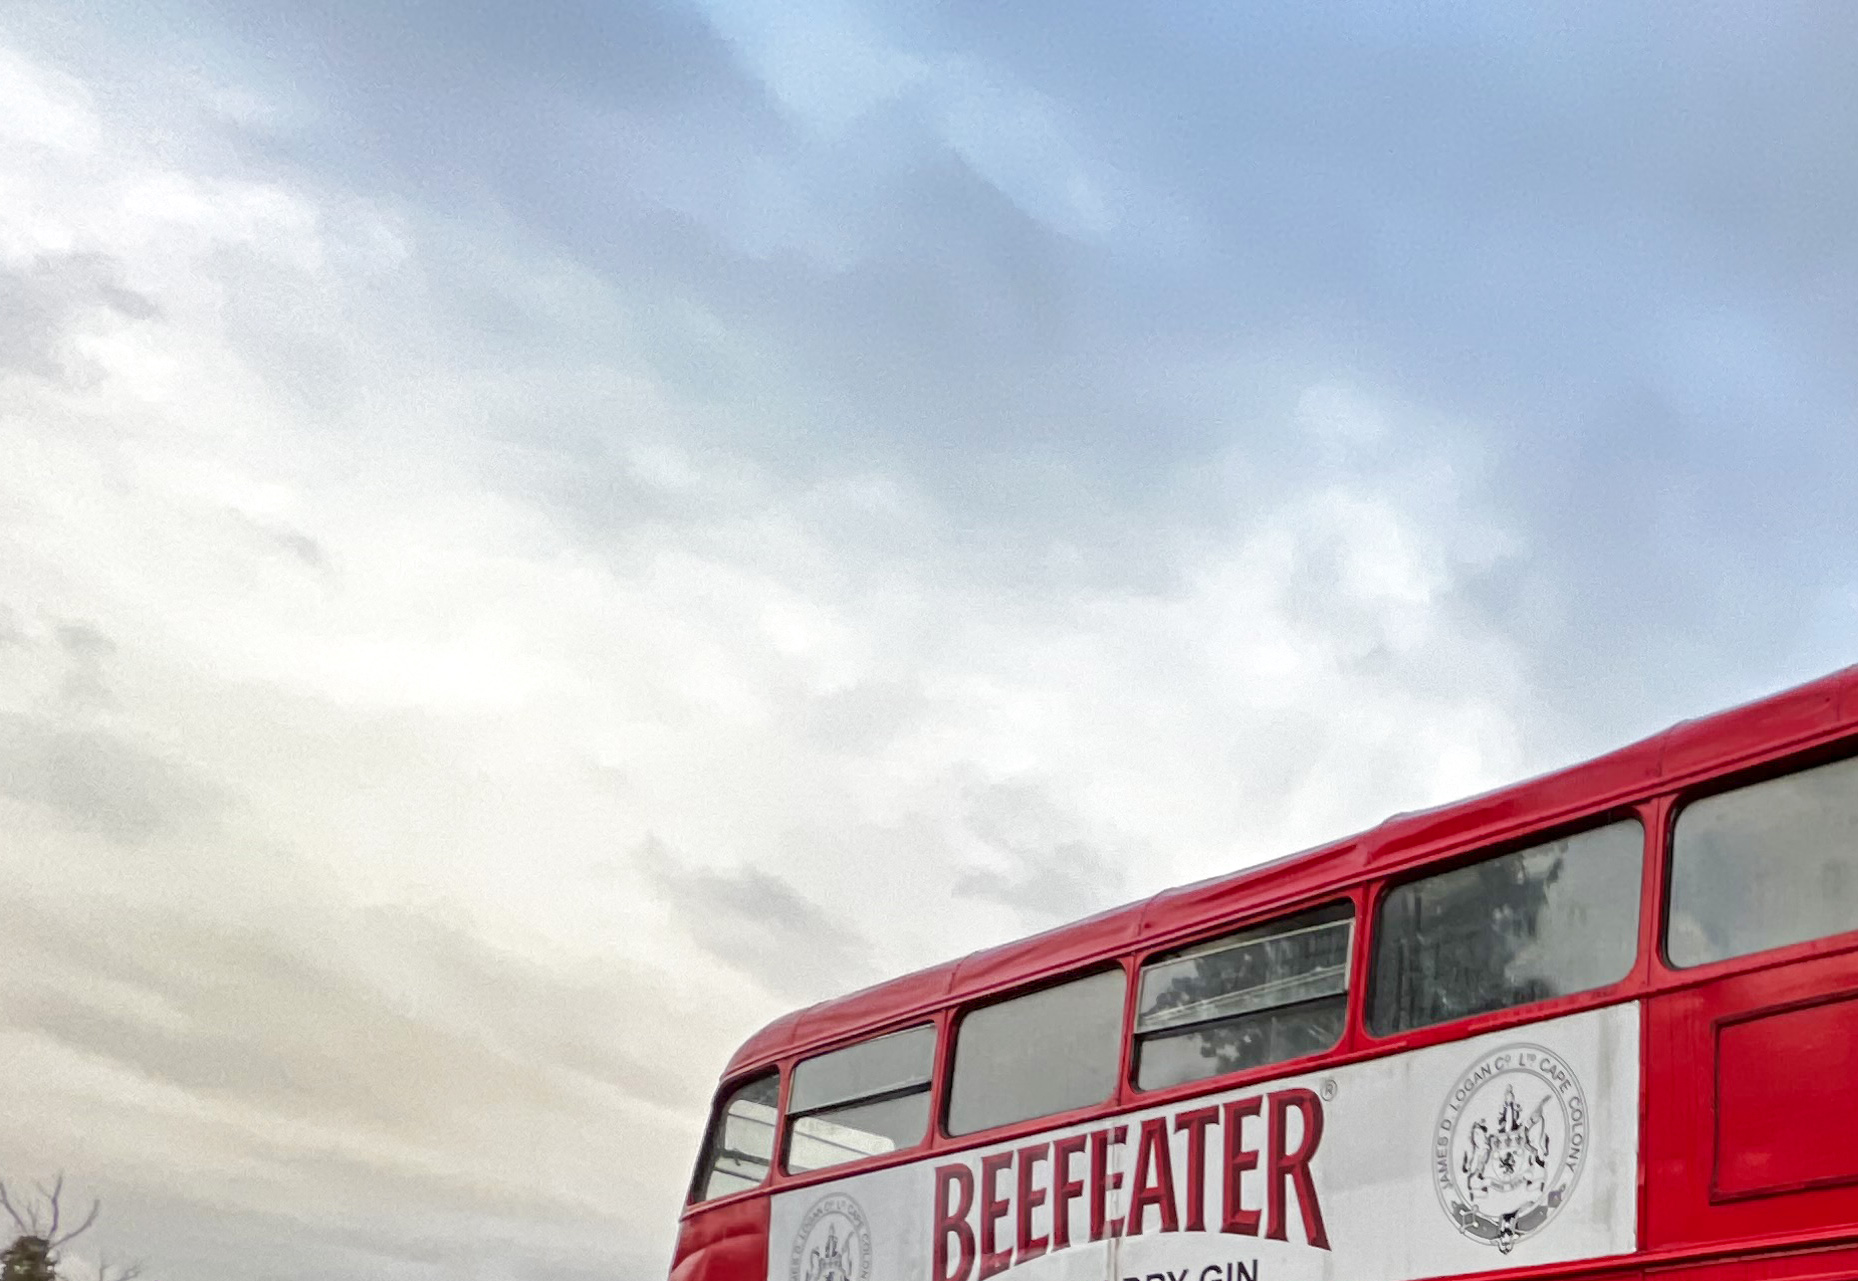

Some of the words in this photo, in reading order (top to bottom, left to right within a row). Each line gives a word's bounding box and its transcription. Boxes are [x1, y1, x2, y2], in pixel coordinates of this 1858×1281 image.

[1437, 1136, 1453, 1190] JAMES
[1450, 1063, 1493, 1112] LOGAN
[1538, 1058, 1572, 1094] CAPE
[1565, 1095, 1584, 1173] COLONY
